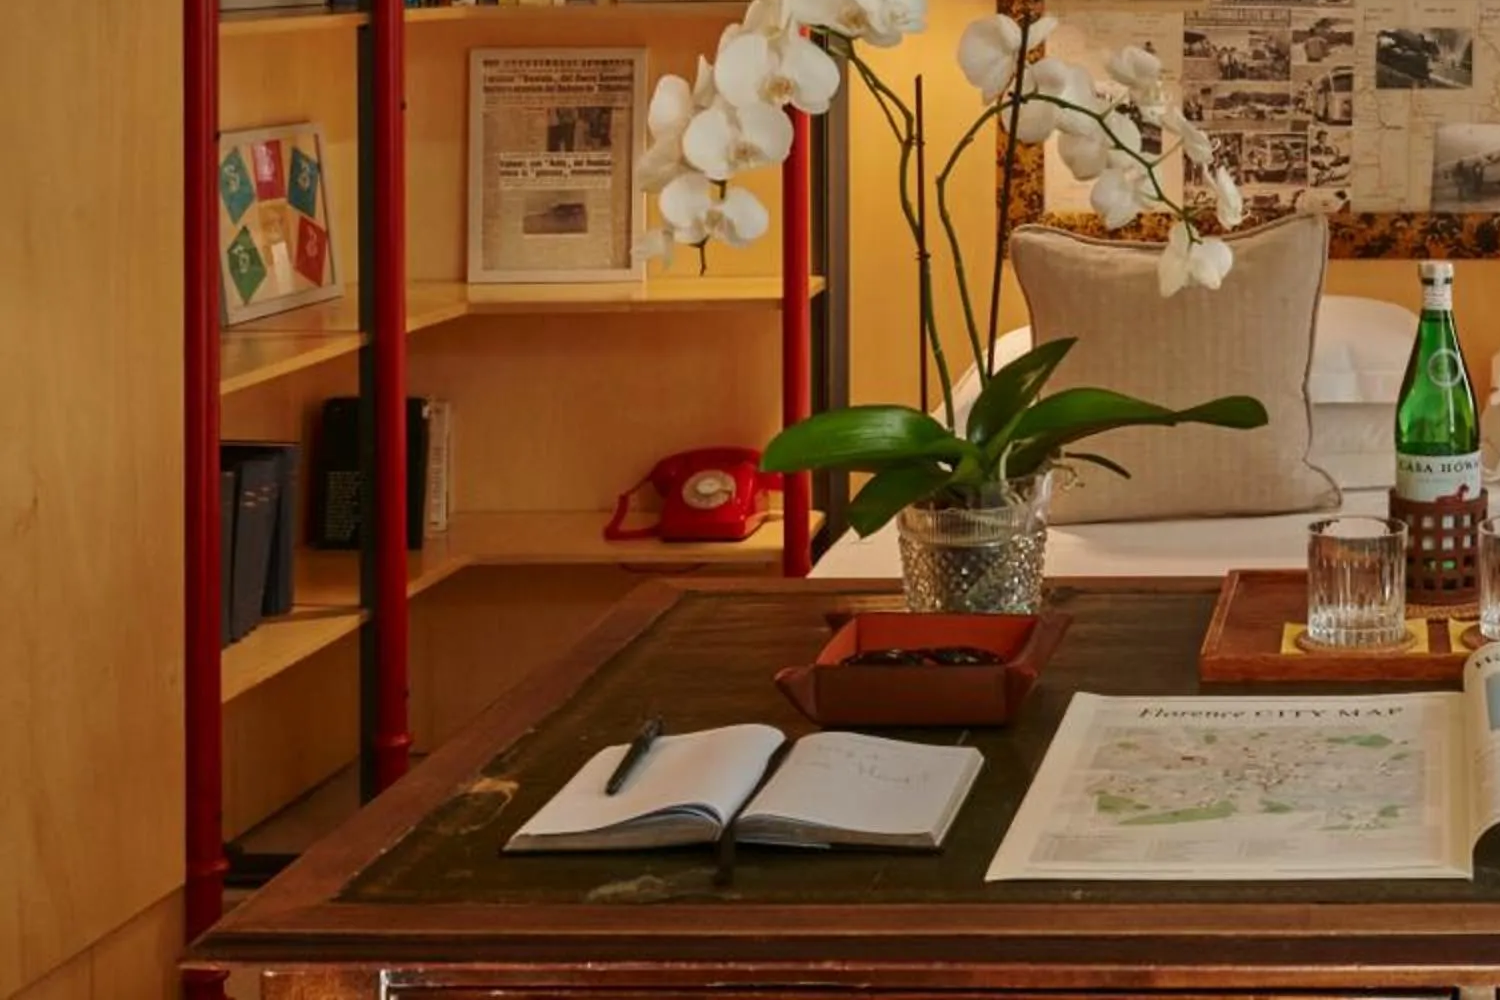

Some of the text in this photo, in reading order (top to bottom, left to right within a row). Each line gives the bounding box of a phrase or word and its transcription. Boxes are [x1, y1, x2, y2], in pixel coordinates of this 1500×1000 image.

[1138, 705, 1404, 720] Florence CITY MAP
